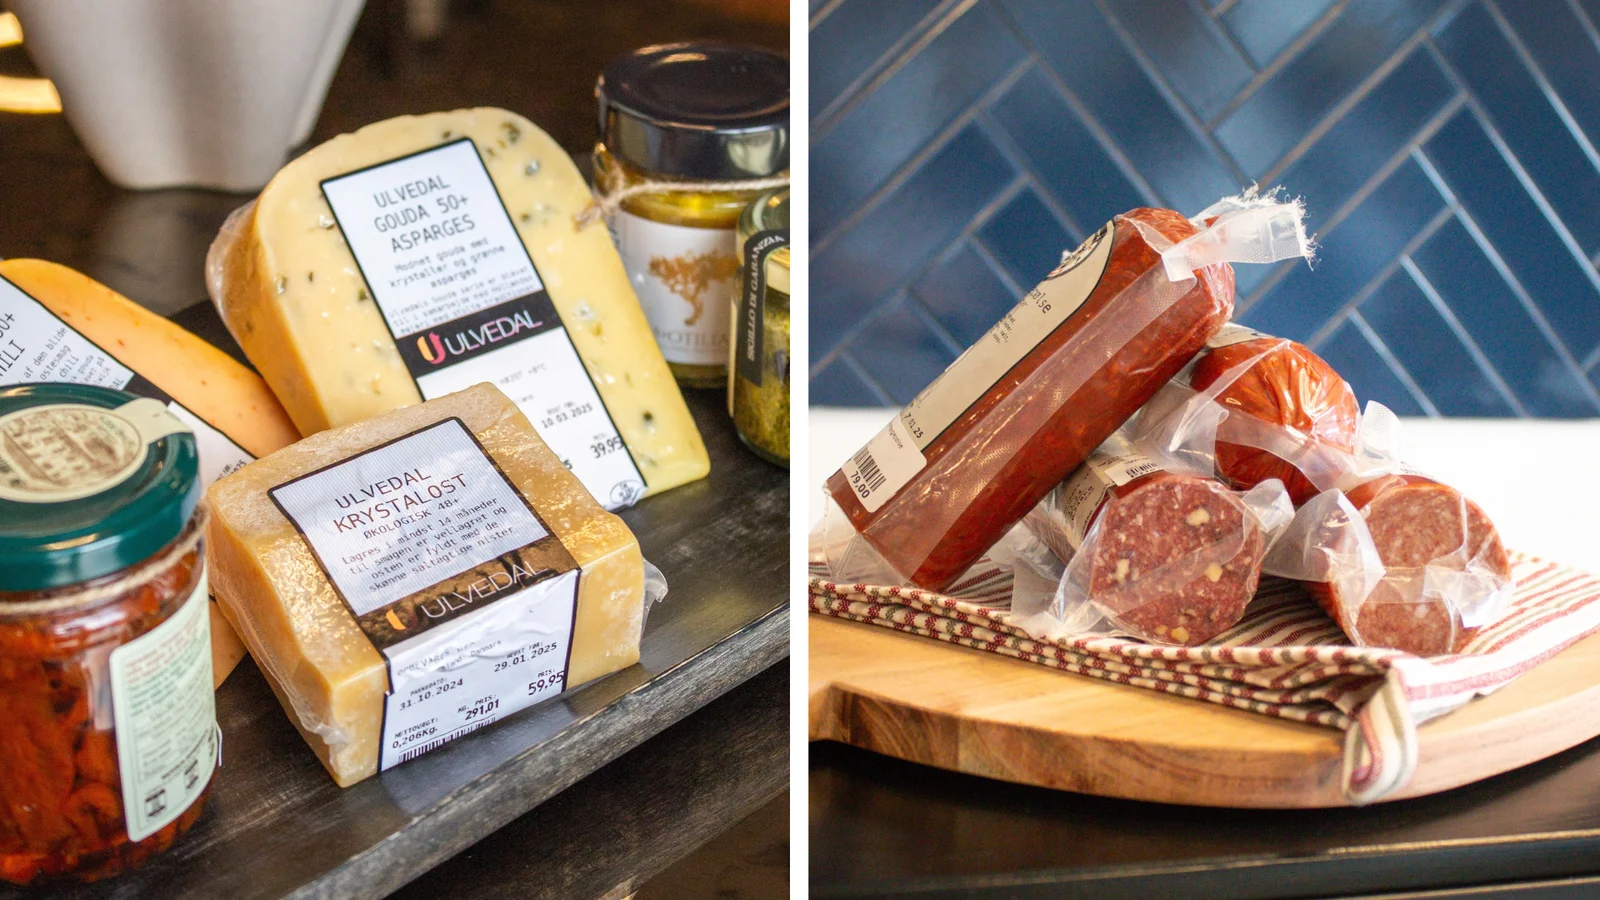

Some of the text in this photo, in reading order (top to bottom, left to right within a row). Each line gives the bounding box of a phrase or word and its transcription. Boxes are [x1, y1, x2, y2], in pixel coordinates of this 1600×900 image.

[373, 174, 451, 208] ULVEDAL
[374, 194, 468, 233] GOUDA 50+
[391, 213, 476, 253] ASPARGES
[389, 263, 448, 288] krystaller
[453, 258, 467, 268] og
[394, 237, 489, 274] Modnet gouda med
[430, 266, 478, 289] asparges
[444, 307, 544, 356] ULVEDAL
[24, 327, 67, 378] af den blide
[40, 344, 72, 381] ostesmag
[59, 354, 80, 378] chili
[590, 435, 625, 459] 39,95
[333, 467, 431, 509] ULVEDAL
[333, 473, 468, 533] KRYSTALOST
[850, 471, 870, 499] 79,00
[342, 545, 381, 565] Lagres
[398, 523, 434, 545] mindst
[438, 516, 452, 527] 14
[456, 496, 498, 520] måneder
[363, 497, 459, 540] ØKOLOGISK 48+
[350, 505, 508, 575] til smagen er vellagret og
[370, 520, 499, 580] osten er fyldt med de
[369, 526, 514, 593] skønne saltagtige nister
[420, 560, 549, 619] ULVEDAL
[494, 642, 558, 673] 29.01.2025
[537, 668, 556, 678] PRIS:
[399, 678, 463, 711] 31.10.2024
[474, 694, 496, 706] PRIS:
[528, 670, 565, 696] 59,95
[465, 698, 500, 720] 291,01
[392, 726, 438, 749] 0,206Kg.
